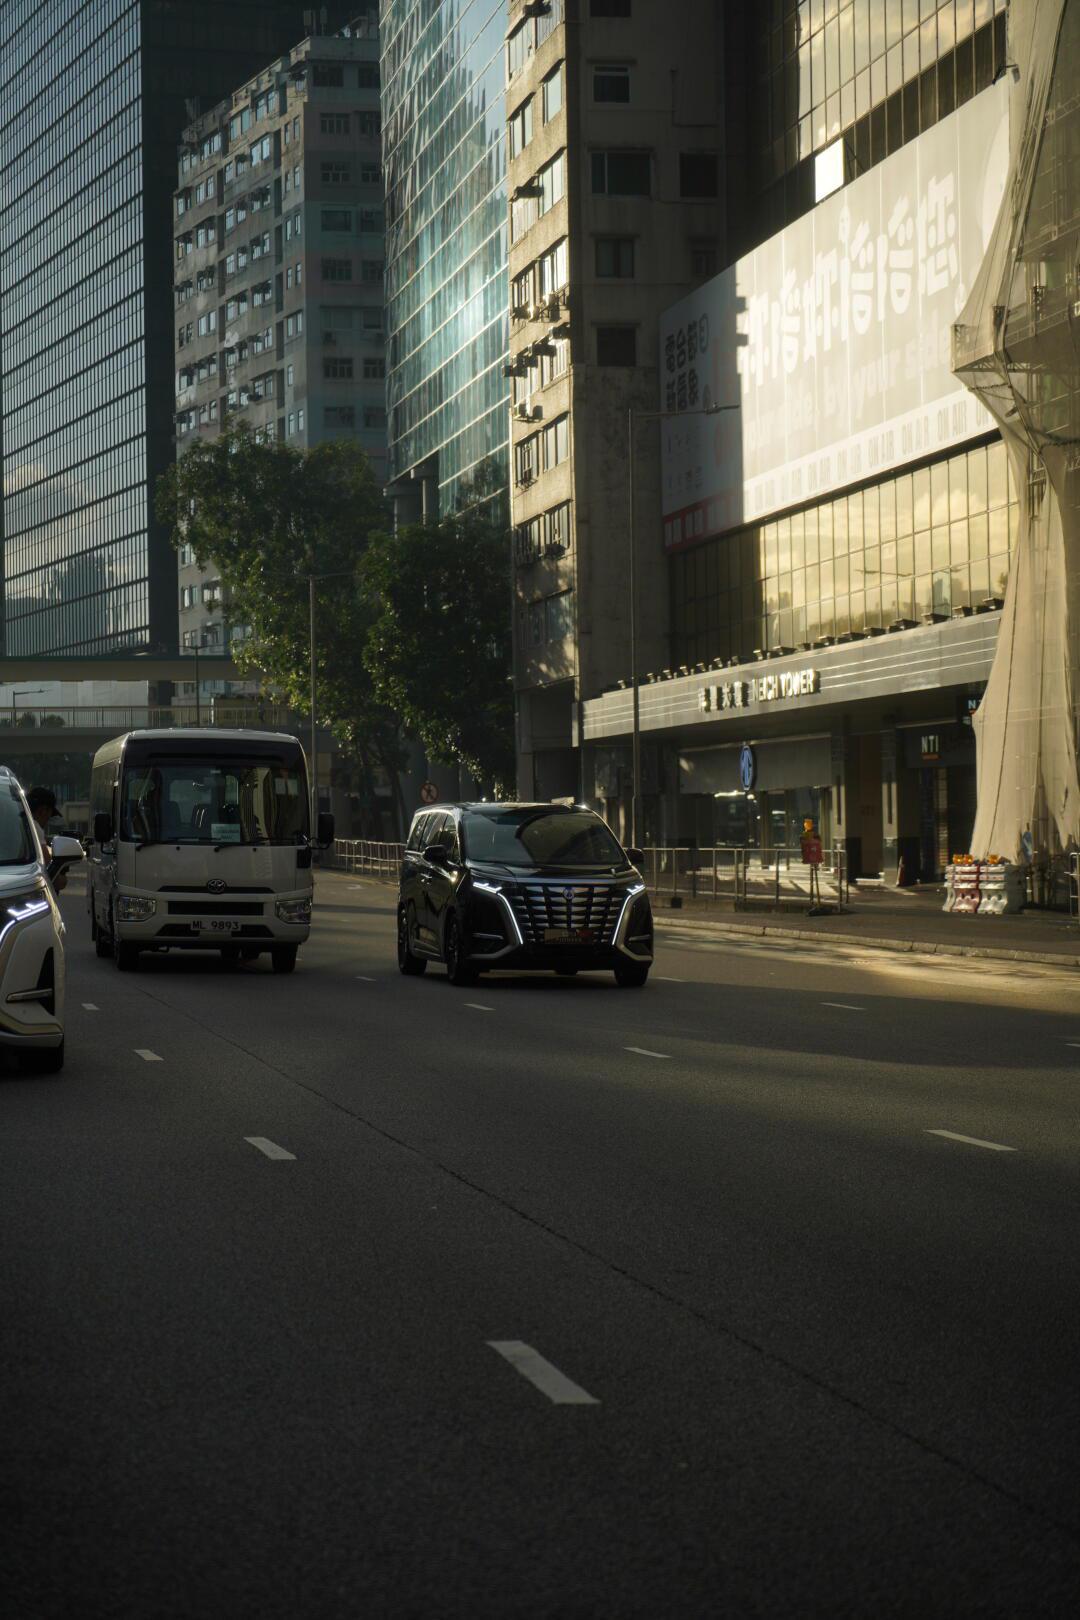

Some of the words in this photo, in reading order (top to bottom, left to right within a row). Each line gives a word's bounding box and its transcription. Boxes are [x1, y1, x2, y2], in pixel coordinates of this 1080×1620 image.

[853, 350, 900, 421] your
[780, 669, 815, 698] TOWER
[921, 735, 940, 753] NTI
[192, 920, 207, 930] ML
[211, 920, 240, 930] 9893
